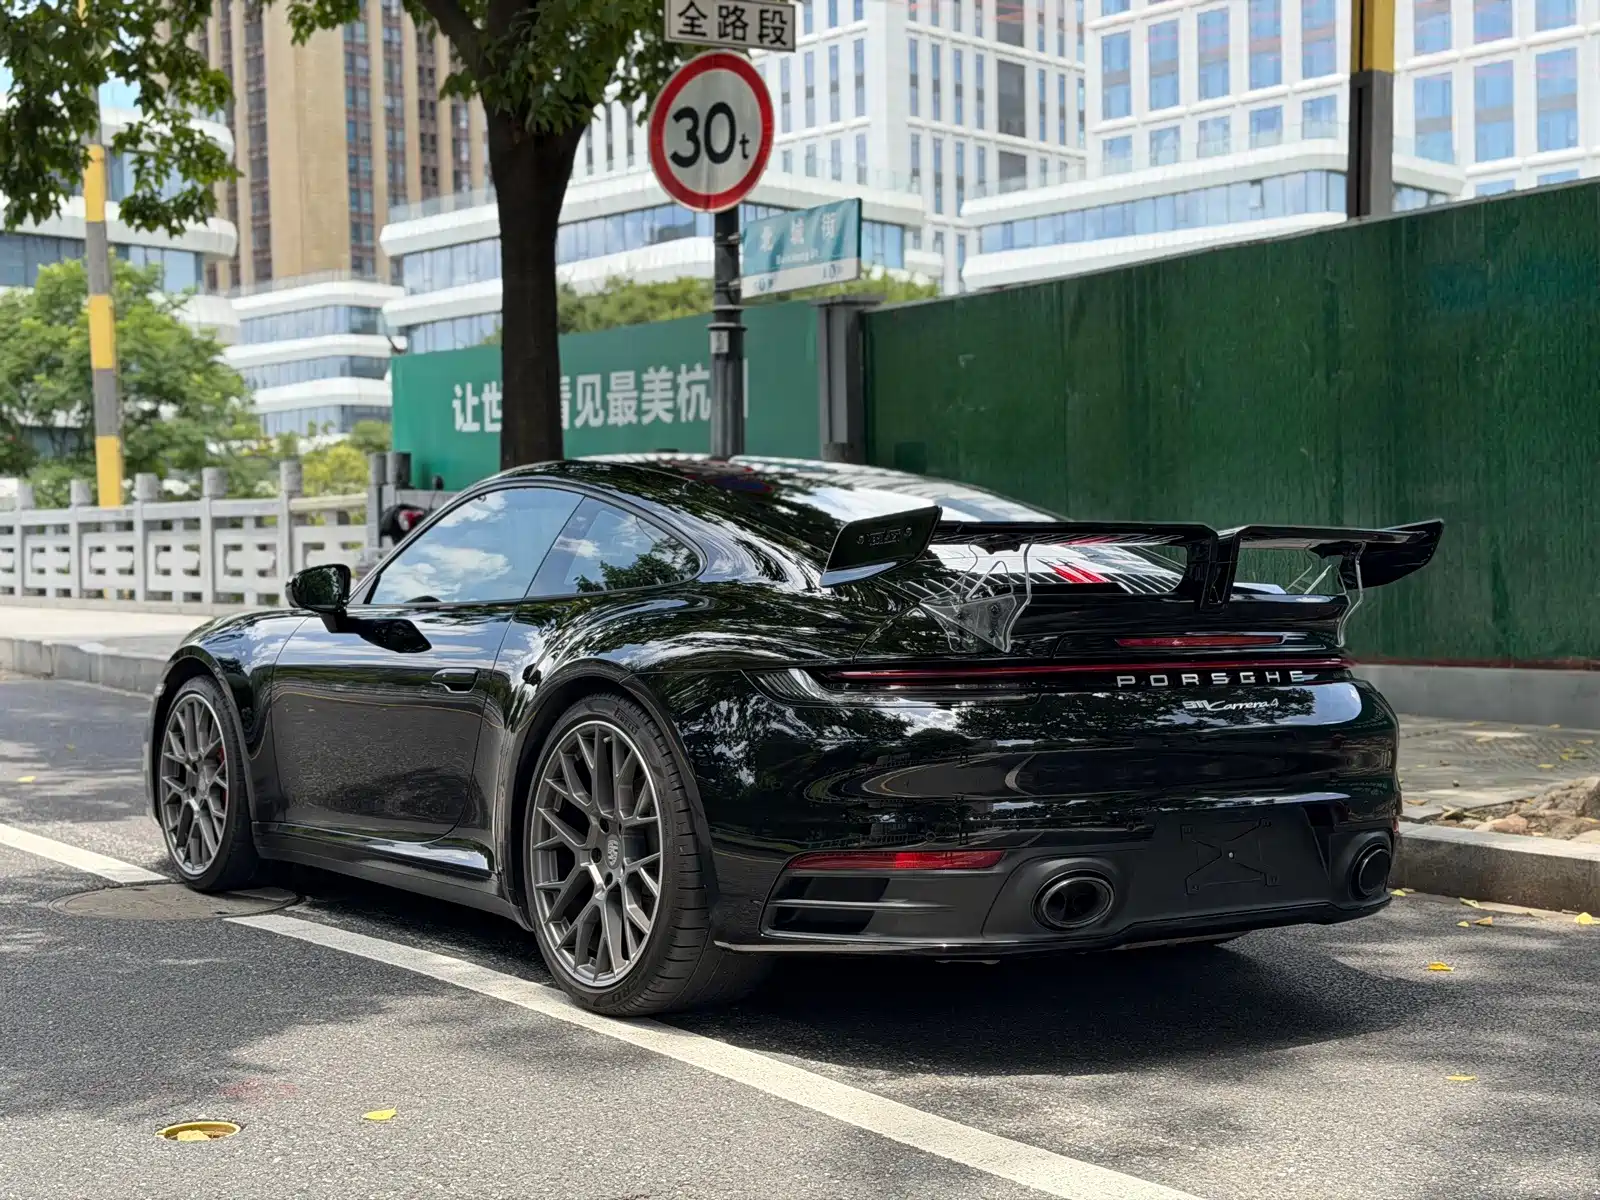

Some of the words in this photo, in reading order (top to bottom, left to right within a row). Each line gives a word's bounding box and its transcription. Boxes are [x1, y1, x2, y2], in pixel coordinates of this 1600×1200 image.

[677, 0, 788, 46] 全路段
[1116, 670, 1303, 688] PORSCHE
[1182, 700, 1209, 710] 911
[1207, 700, 1269, 711] Carrera
